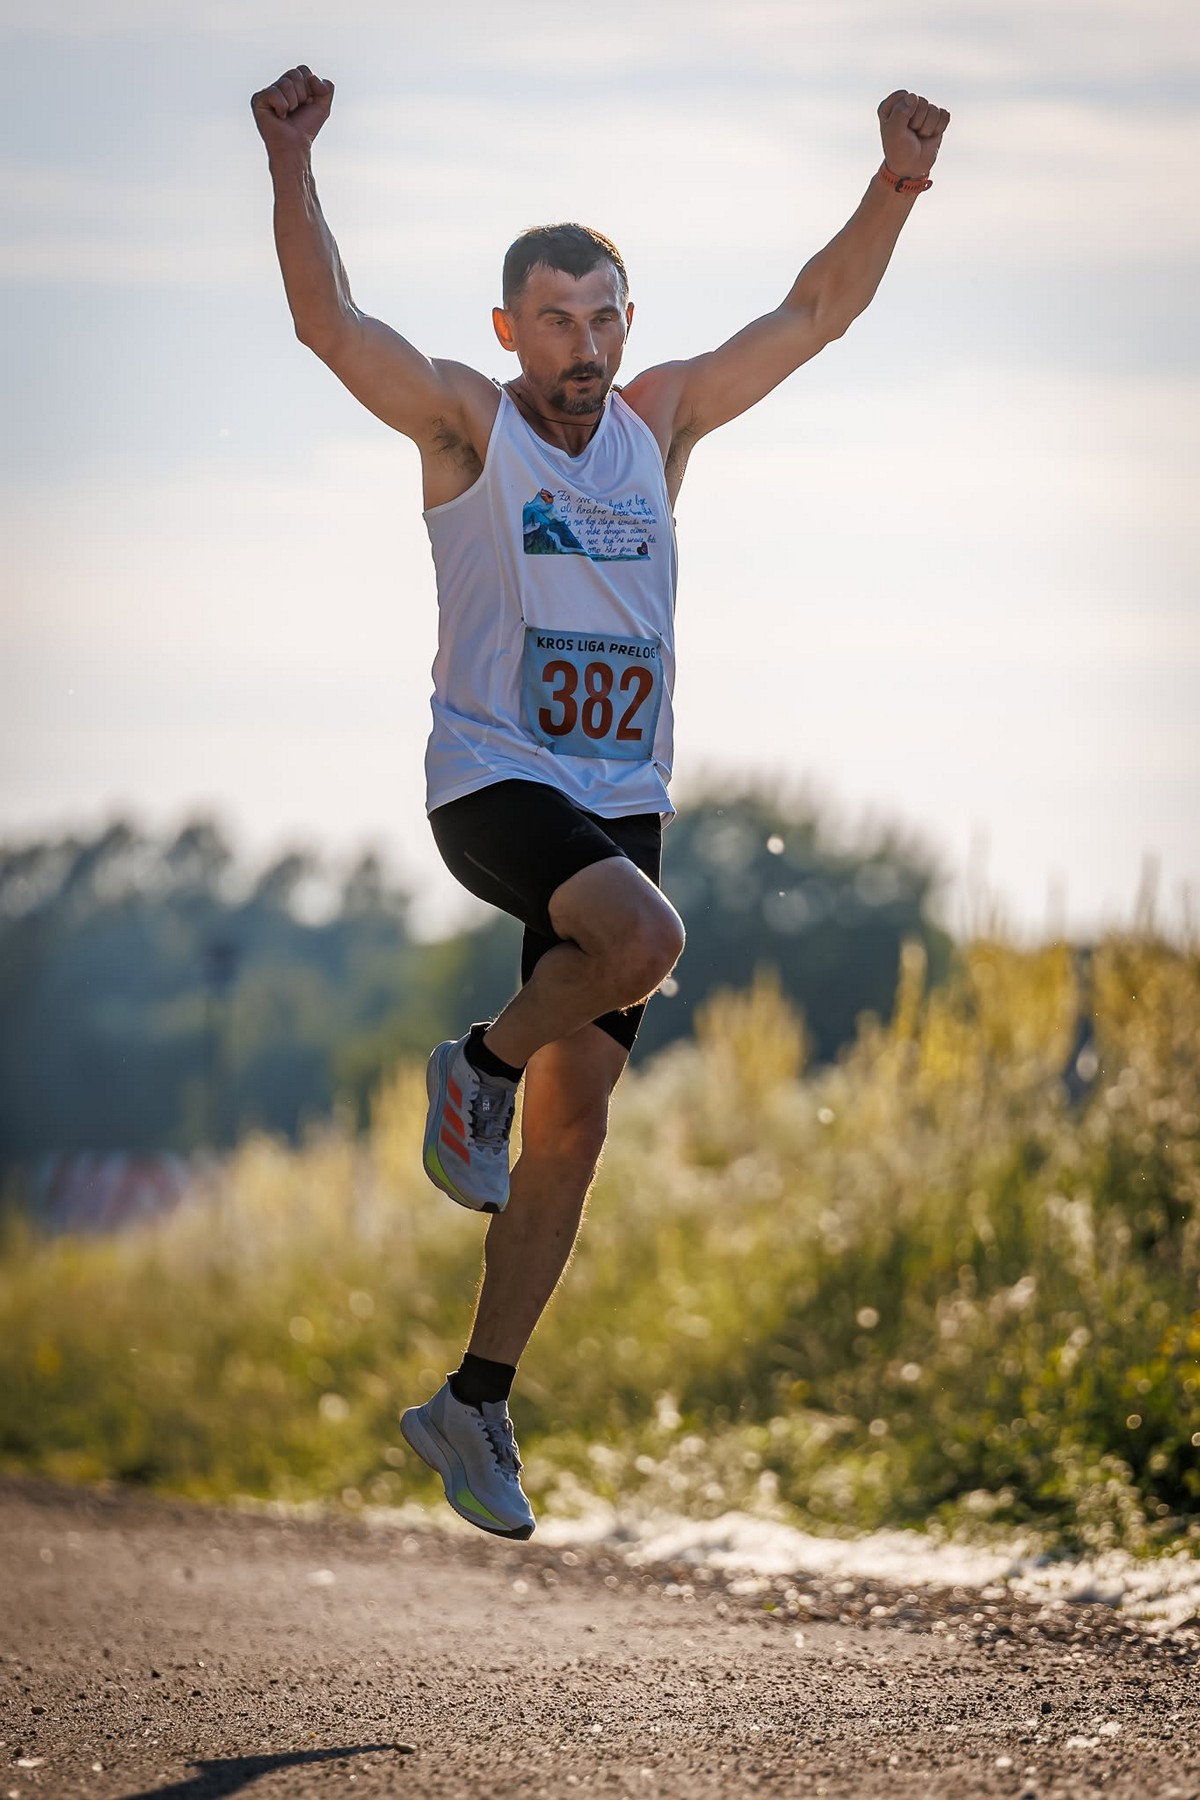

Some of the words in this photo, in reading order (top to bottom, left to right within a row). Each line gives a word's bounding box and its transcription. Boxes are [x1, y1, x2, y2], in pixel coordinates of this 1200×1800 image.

[537, 636, 574, 651] KROS
[577, 640, 605, 653] LIGA
[608, 643, 656, 659] PRELOG
[538, 660, 654, 741] 382
